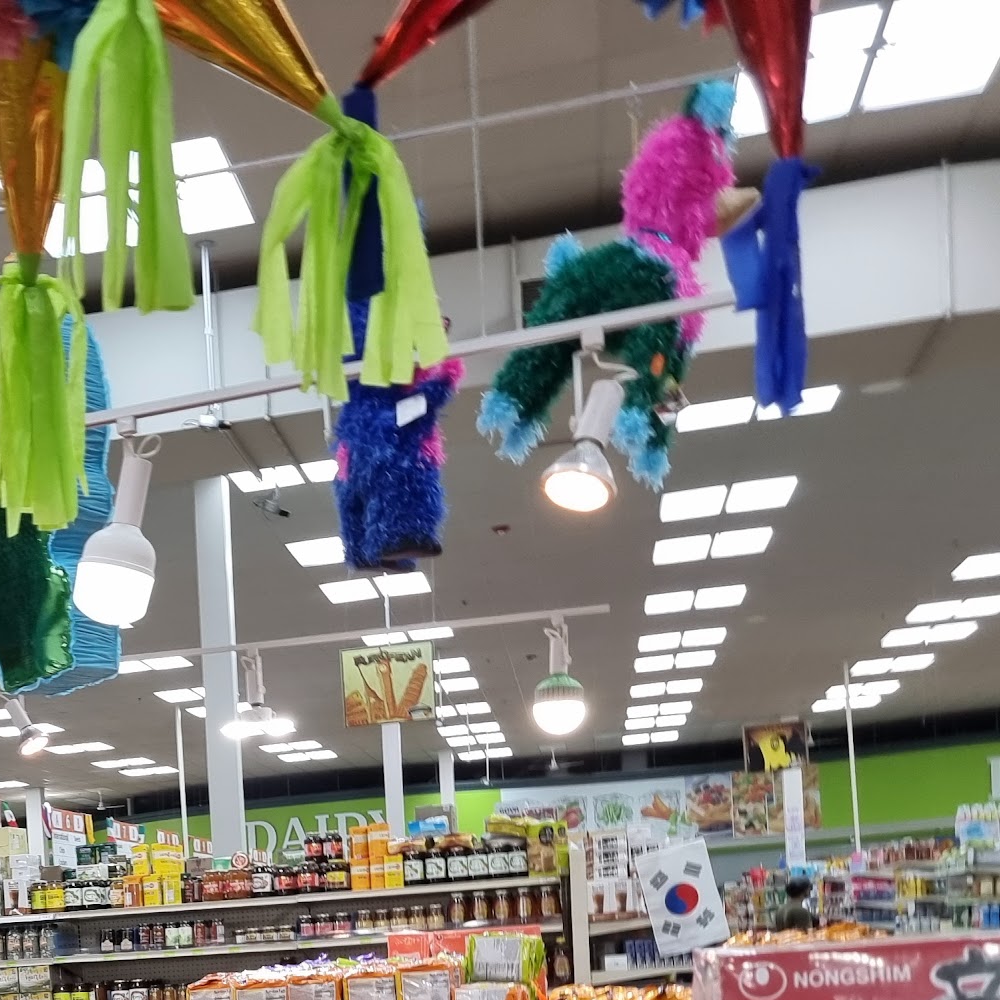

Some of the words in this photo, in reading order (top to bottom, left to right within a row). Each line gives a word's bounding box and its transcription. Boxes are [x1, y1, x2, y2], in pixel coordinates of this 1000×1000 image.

[65, 813, 71, 828] 6
[246, 810, 386, 866] DAIR
[793, 965, 912, 989] NONGSHIM
